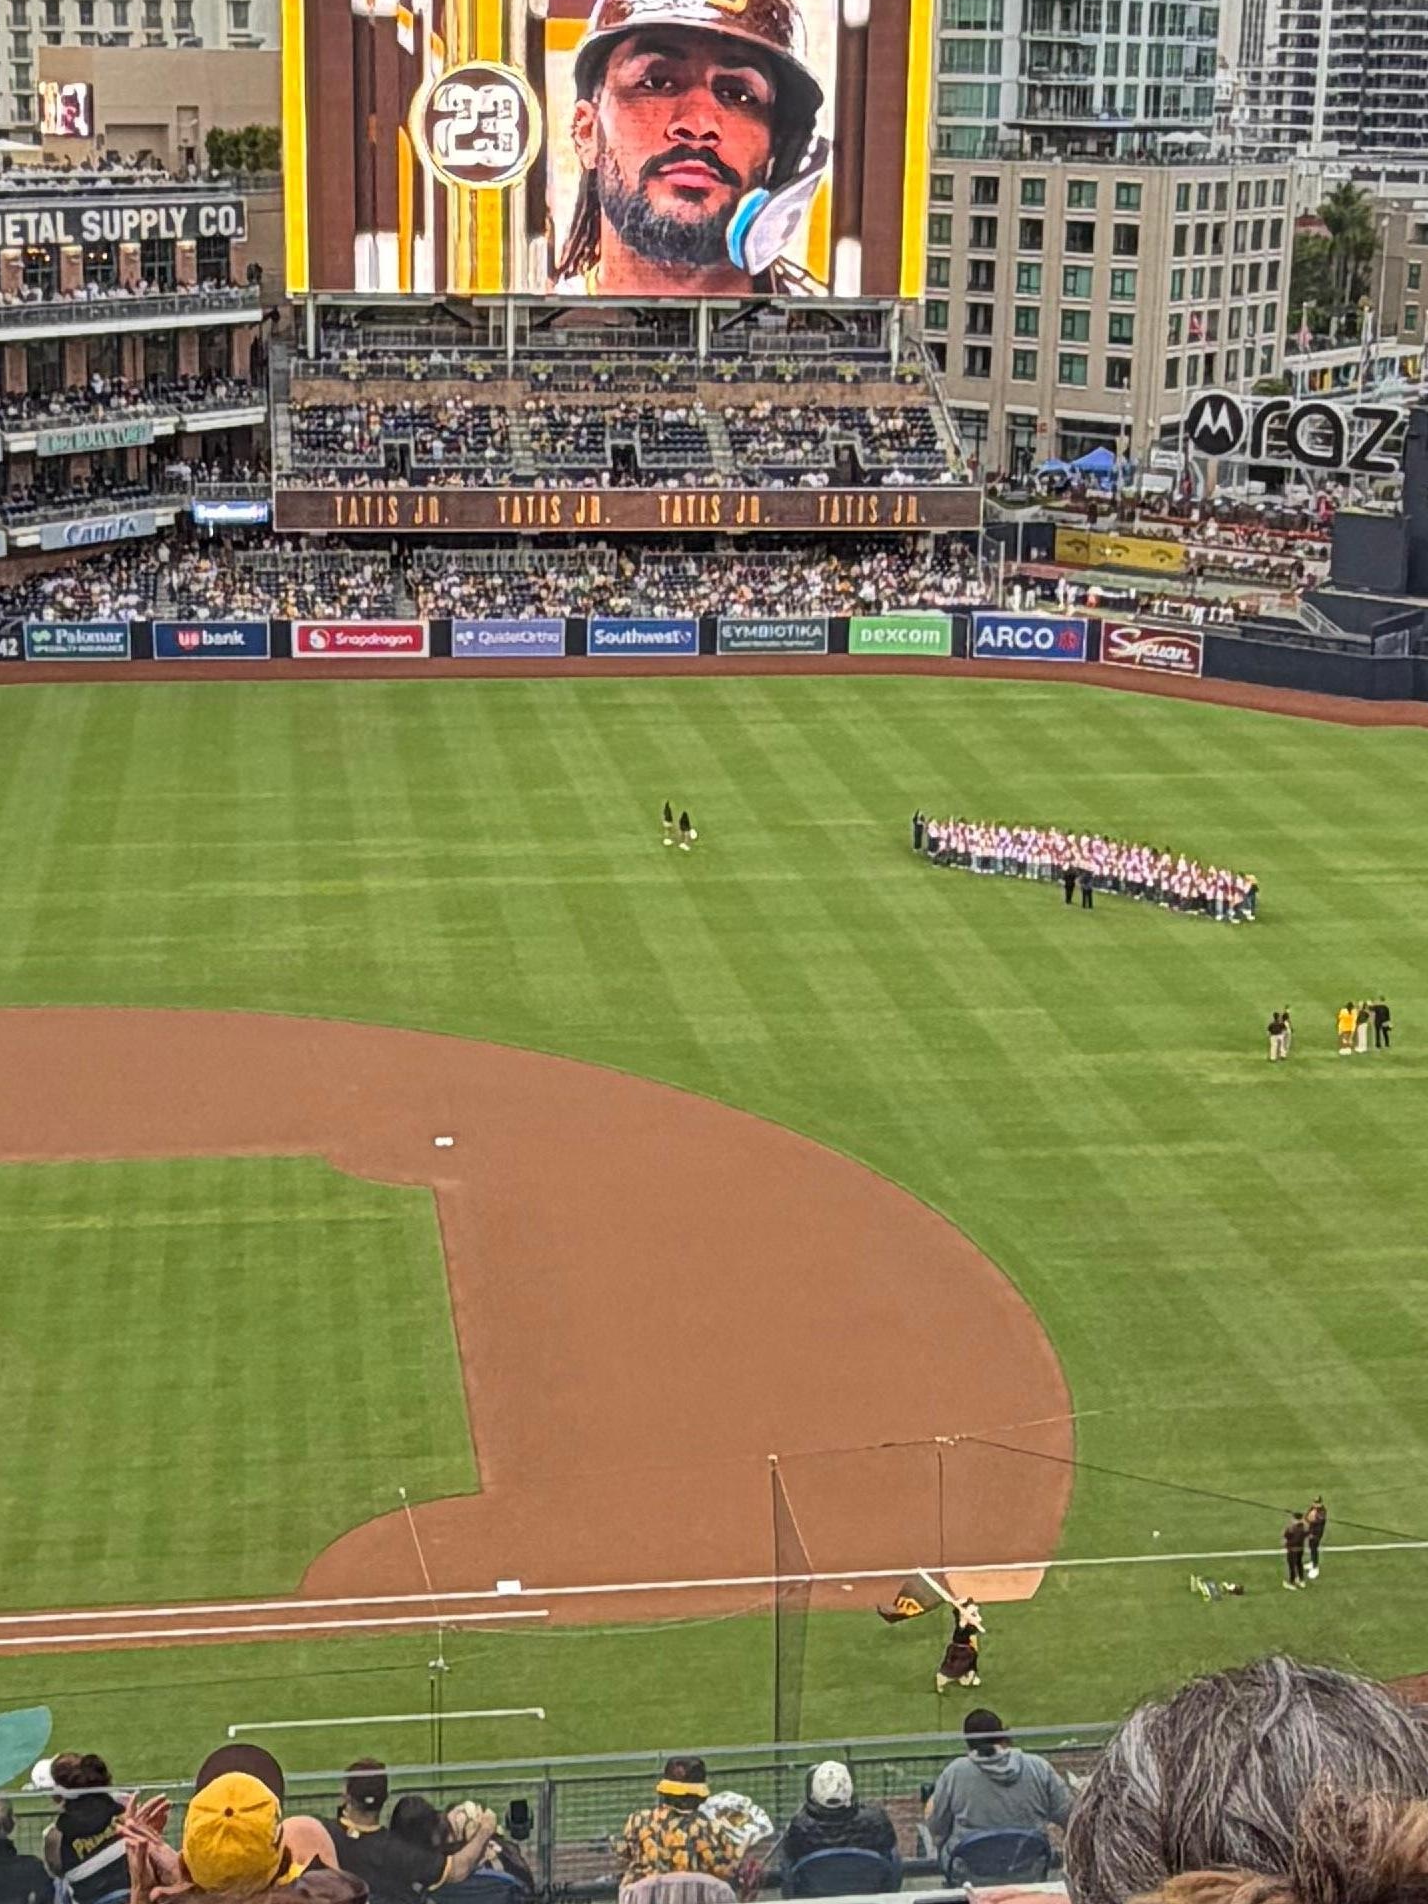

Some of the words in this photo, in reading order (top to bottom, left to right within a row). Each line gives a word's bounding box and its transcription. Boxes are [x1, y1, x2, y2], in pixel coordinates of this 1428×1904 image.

[433, 83, 521, 166] 23
[81, 204, 185, 243] SUPPLY
[199, 204, 245, 238] CO.
[335, 495, 399, 526] TATIS
[414, 495, 449, 526] JR.
[498, 495, 561, 526] TATIS
[577, 495, 611, 526] JR.
[659, 495, 721, 526] TATIS
[736, 495, 772, 526] JR.
[817, 495, 879, 526] TATIS
[894, 495, 927, 526] JR.
[54, 628, 124, 644] Palomar
[202, 629, 243, 646] bank
[334, 632, 414, 648] Snapdragon
[594, 628, 680, 645] Southwest
[977, 625, 1055, 649] ARCO
[1108, 627, 1192, 670] Sycuan
